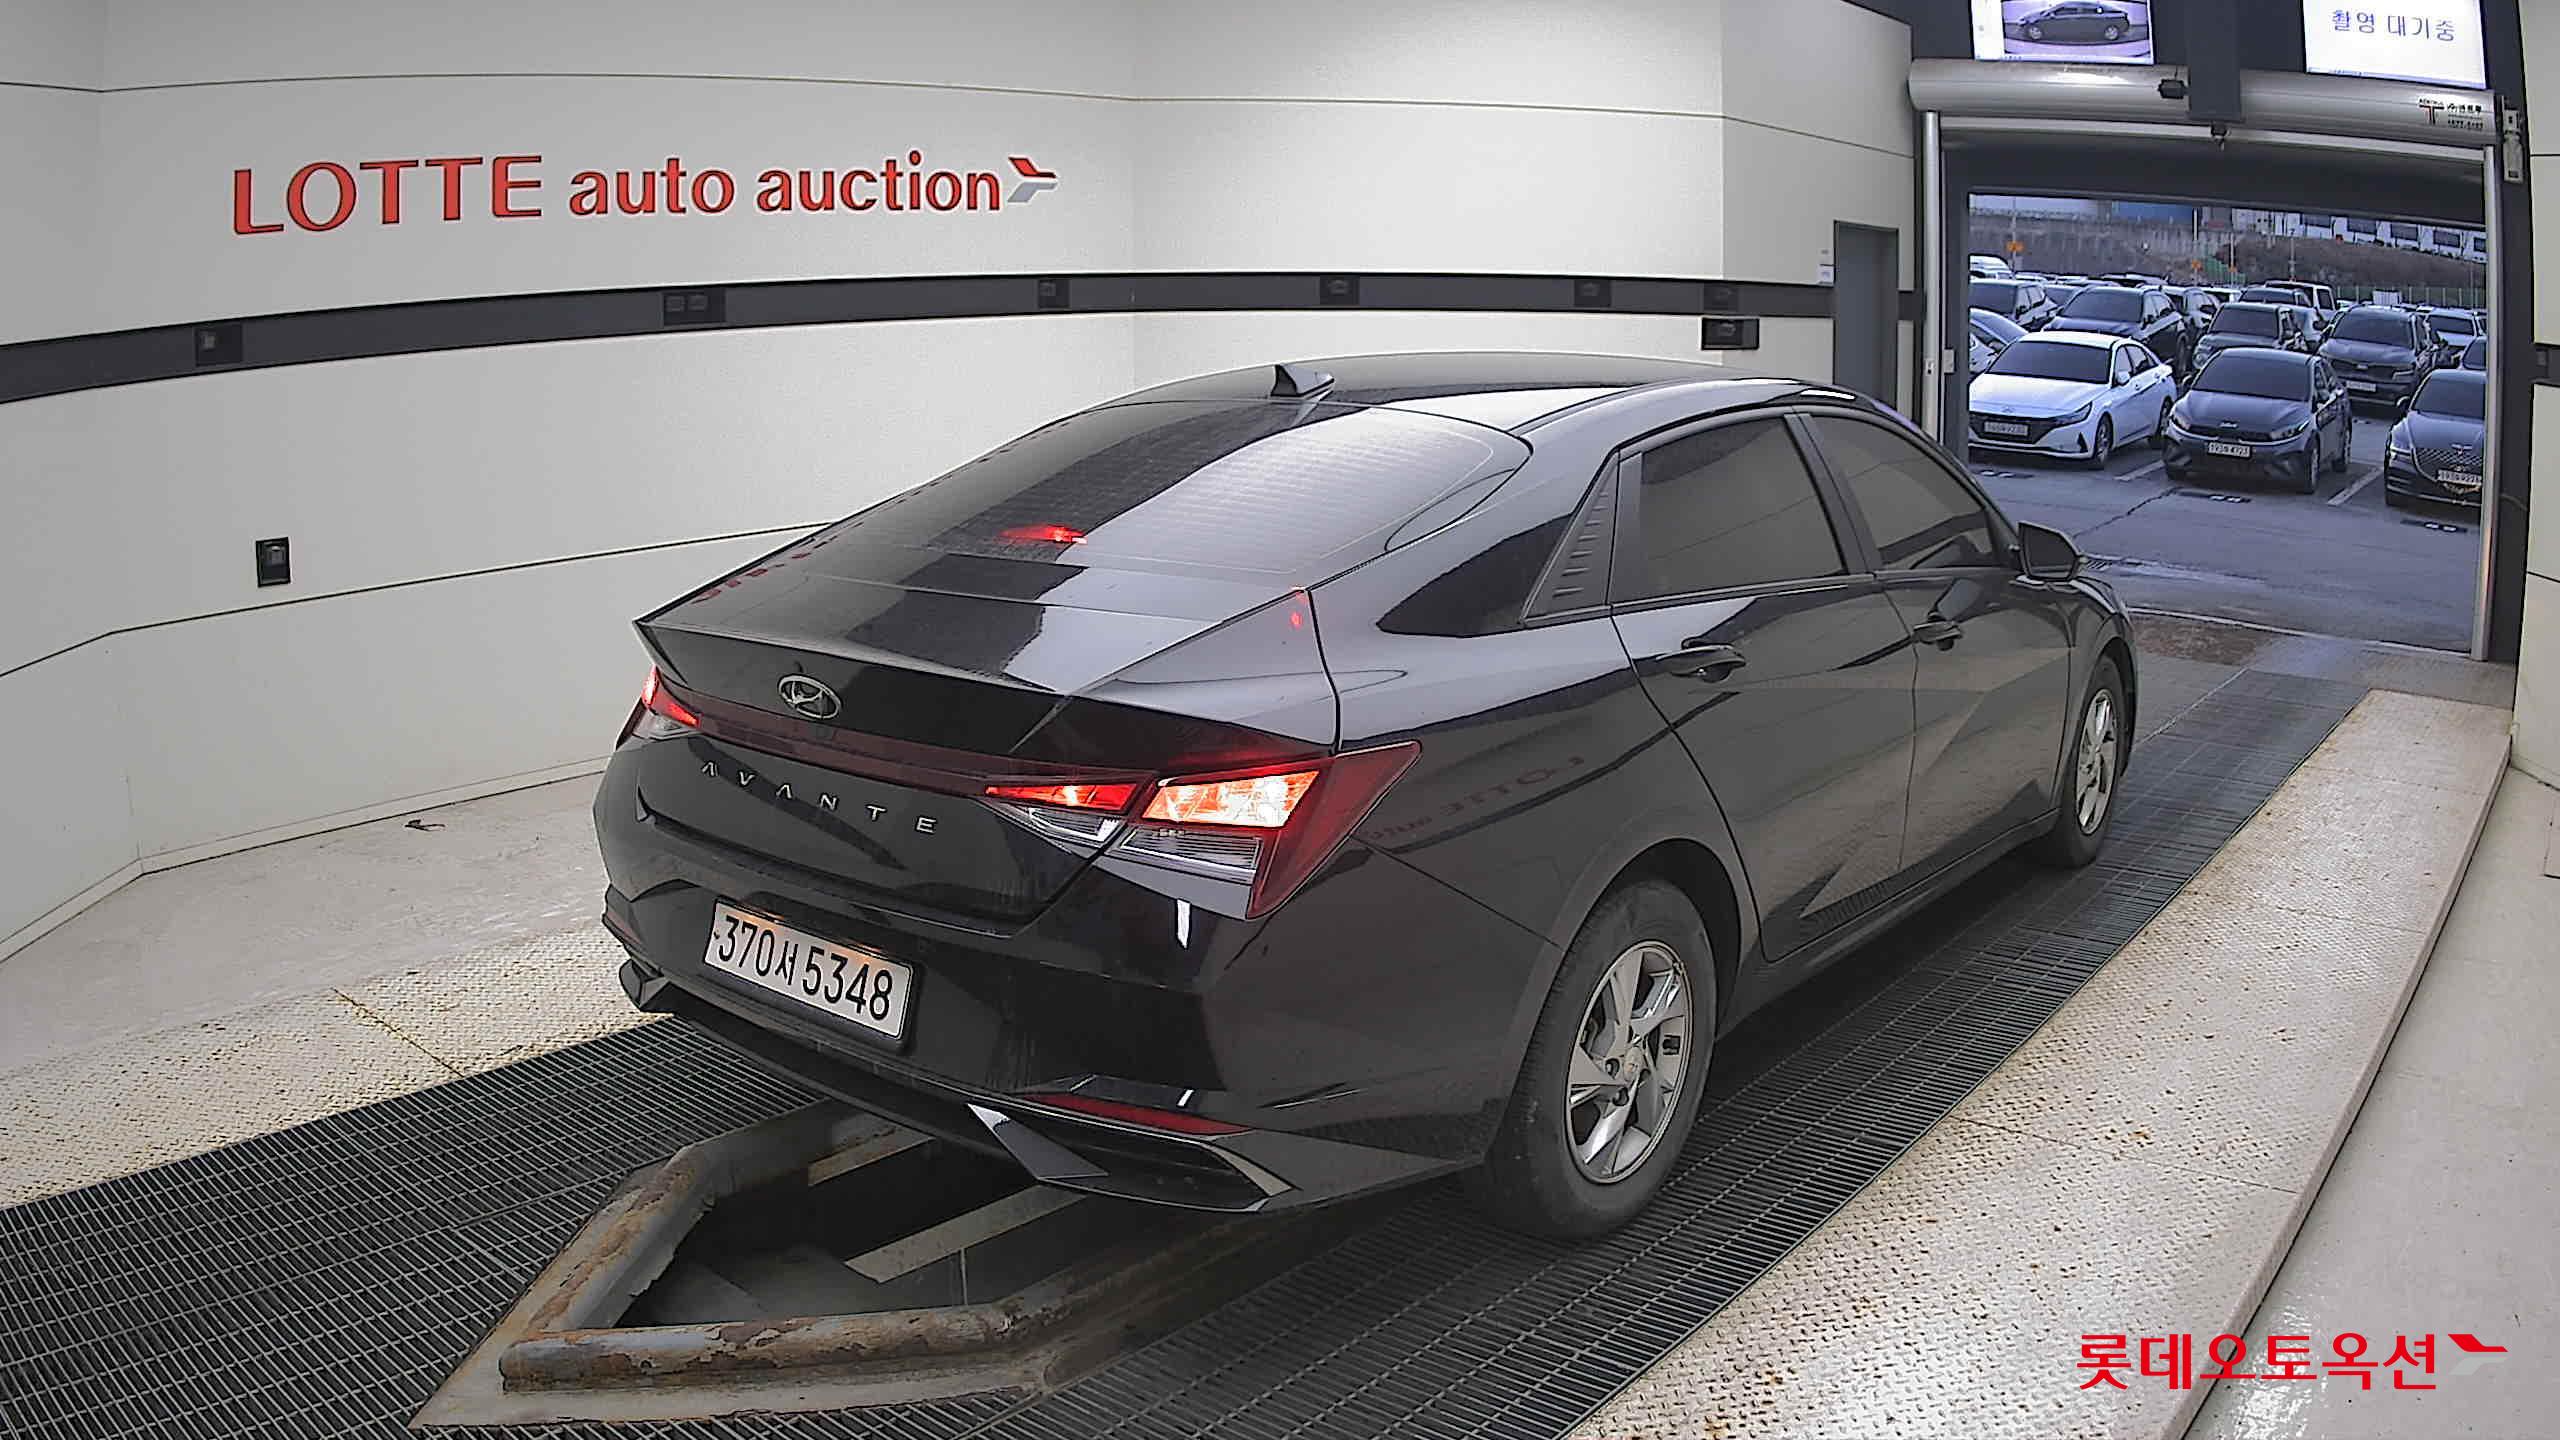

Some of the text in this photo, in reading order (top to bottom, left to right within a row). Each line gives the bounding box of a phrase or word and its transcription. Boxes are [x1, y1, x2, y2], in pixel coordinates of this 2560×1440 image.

[2332, 9, 2454, 42] 촬영 대기중
[234, 151, 1001, 234] LOTTE auto auction
[701, 761, 937, 834] AVANTE
